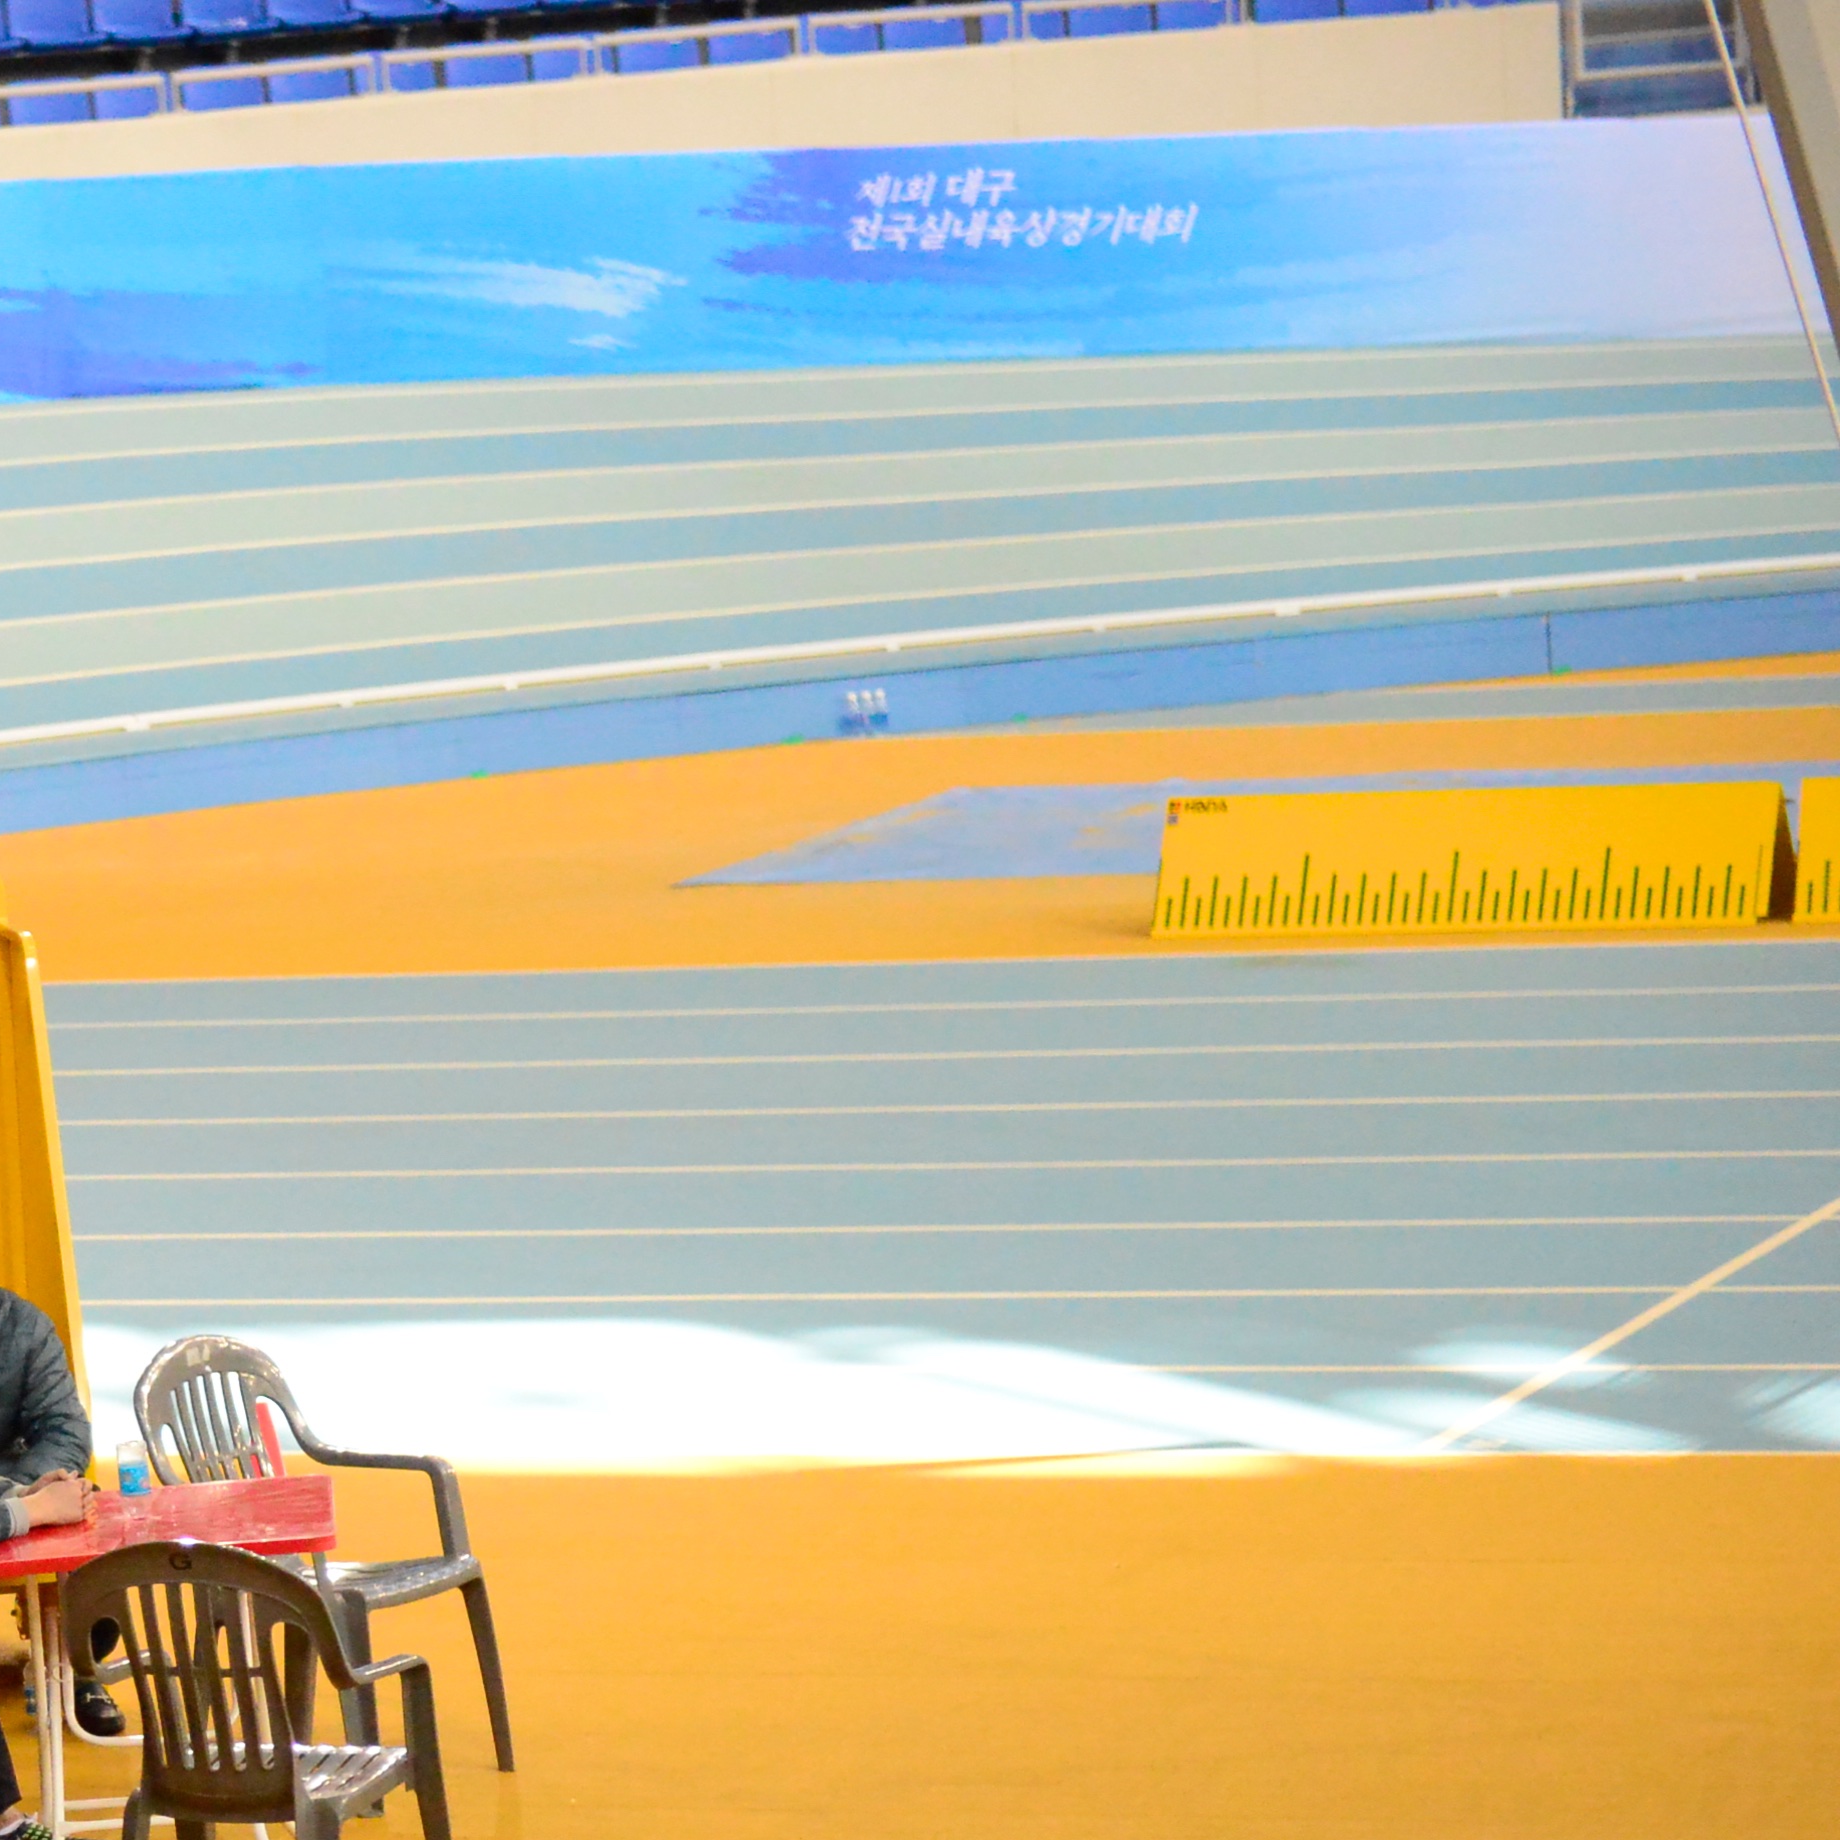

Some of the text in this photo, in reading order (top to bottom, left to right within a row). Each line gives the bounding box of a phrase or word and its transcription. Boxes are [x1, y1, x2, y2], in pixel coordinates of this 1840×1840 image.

[857, 167, 1017, 209] 제1회 대구
[848, 202, 1198, 251] 전국실내육상경기대회
